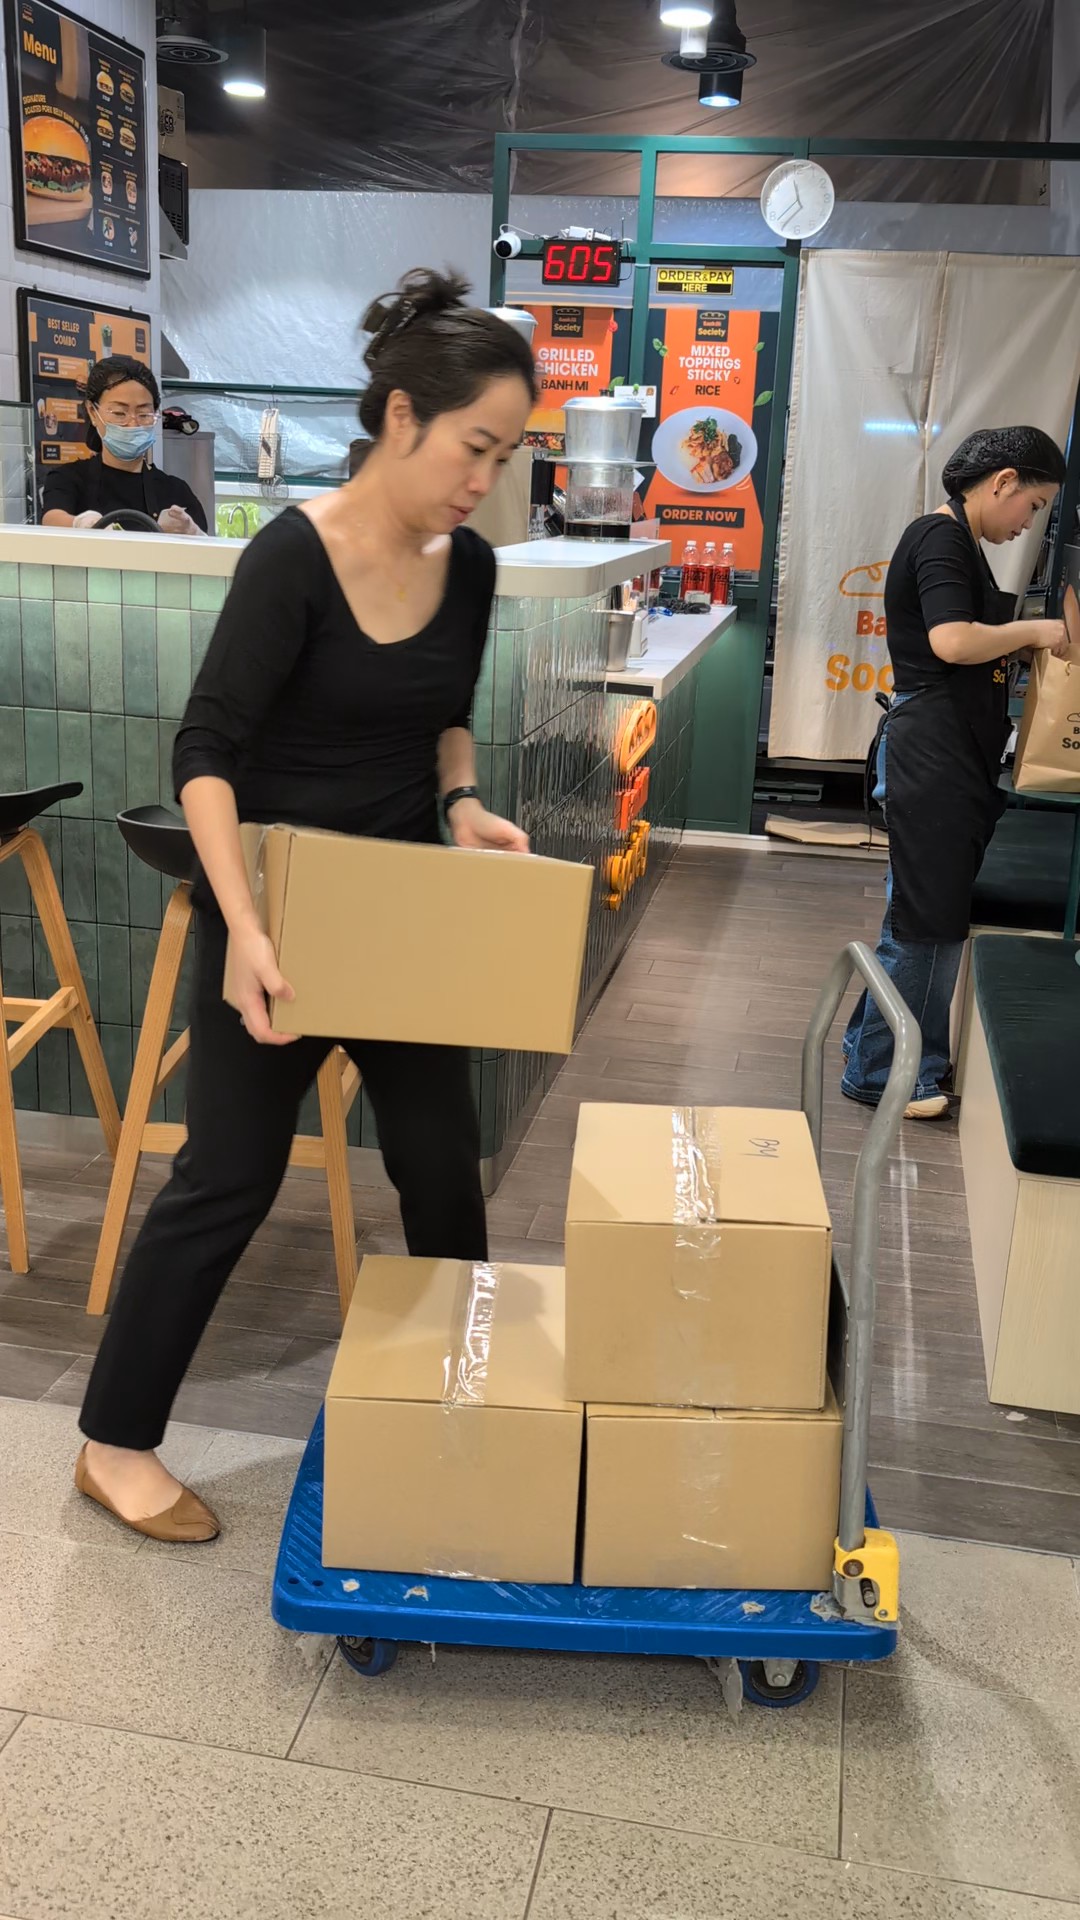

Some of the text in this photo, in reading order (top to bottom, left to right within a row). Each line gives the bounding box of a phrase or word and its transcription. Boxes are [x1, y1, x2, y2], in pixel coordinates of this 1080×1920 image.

[23, 30, 57, 65] Menu
[544, 246, 613, 281] 605
[681, 283, 708, 293] HERE
[47, 317, 80, 334] BEST SELLER
[553, 323, 581, 333] Society
[697, 327, 727, 338] Society
[53, 334, 77, 347] COMBO
[538, 347, 595, 363] GRILLED
[691, 345, 731, 358] MIXED
[535, 361, 599, 377] CHICKEN
[679, 356, 742, 370] TOPPINGS
[687, 368, 731, 382] STICKY
[541, 380, 589, 391] BANH MI
[695, 384, 721, 396] RICE
[662, 508, 738, 522] ORDER NOW
